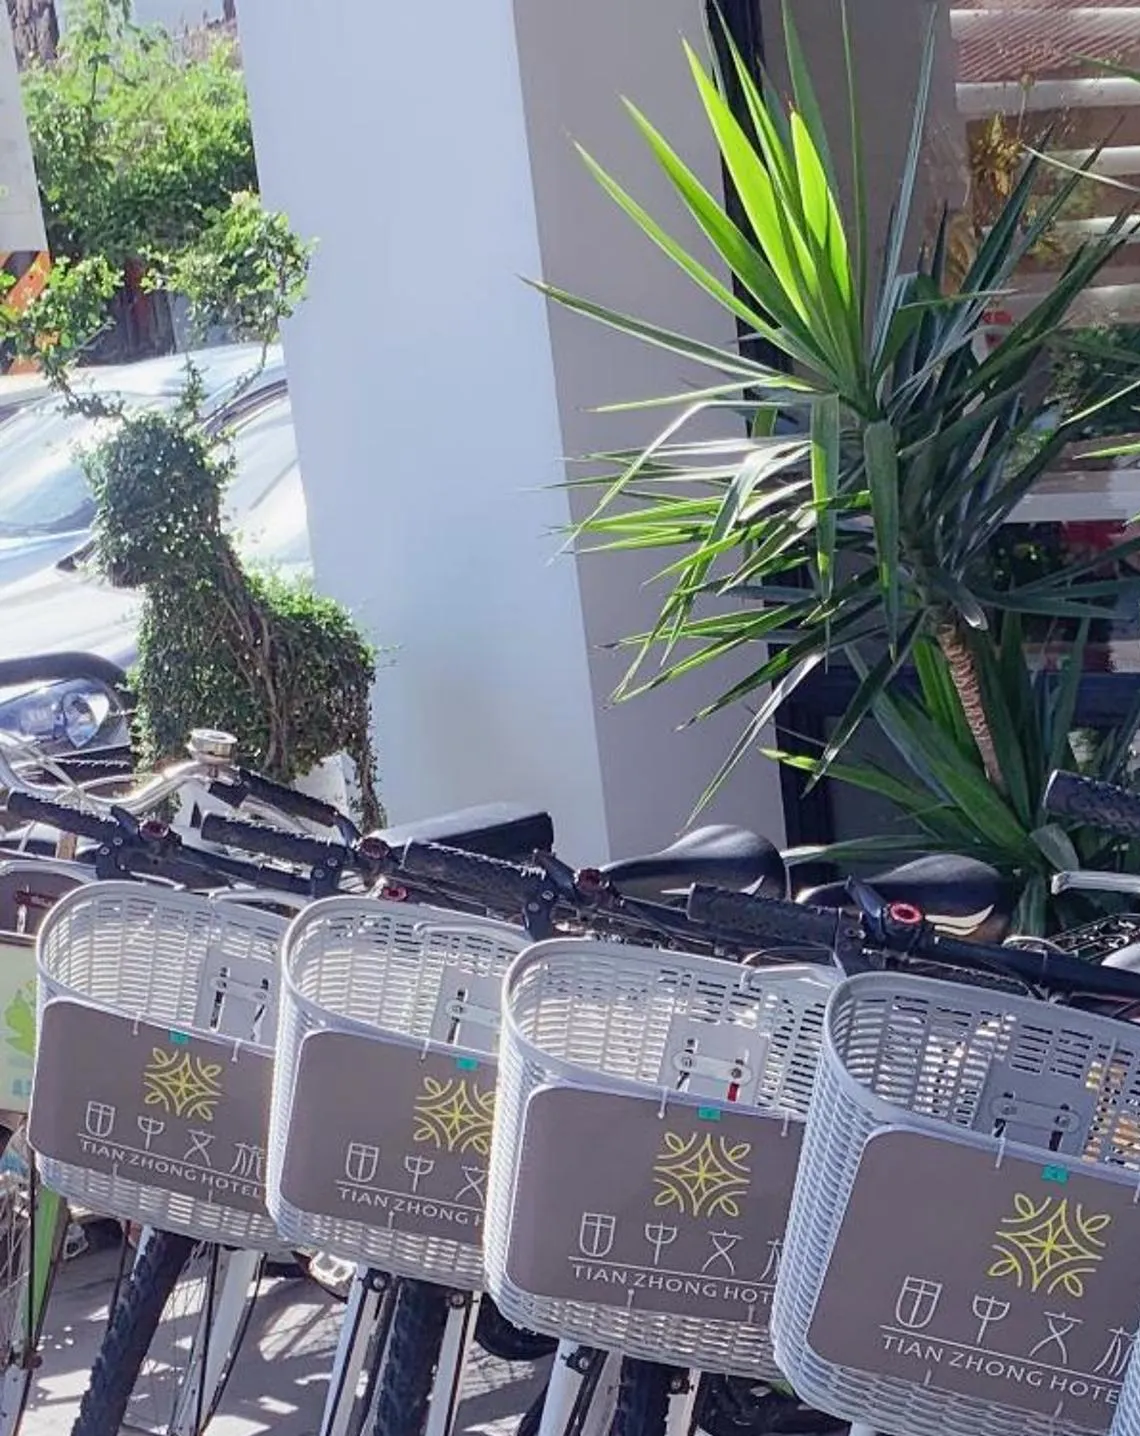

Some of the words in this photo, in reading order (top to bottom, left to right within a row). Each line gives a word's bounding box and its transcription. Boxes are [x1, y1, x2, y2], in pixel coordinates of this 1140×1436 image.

[80, 1138, 125, 1160] TIAN
[126, 1149, 197, 1181] ZHONG
[201, 1174, 261, 1197] HOTEL
[339, 1187, 388, 1207] TIAN
[394, 1198, 468, 1226] ZHONG
[572, 1264, 628, 1284] TIAN
[633, 1273, 717, 1298] ZHONG
[882, 1334, 943, 1362] TIAN
[949, 1352, 1042, 1387] ZHONG
